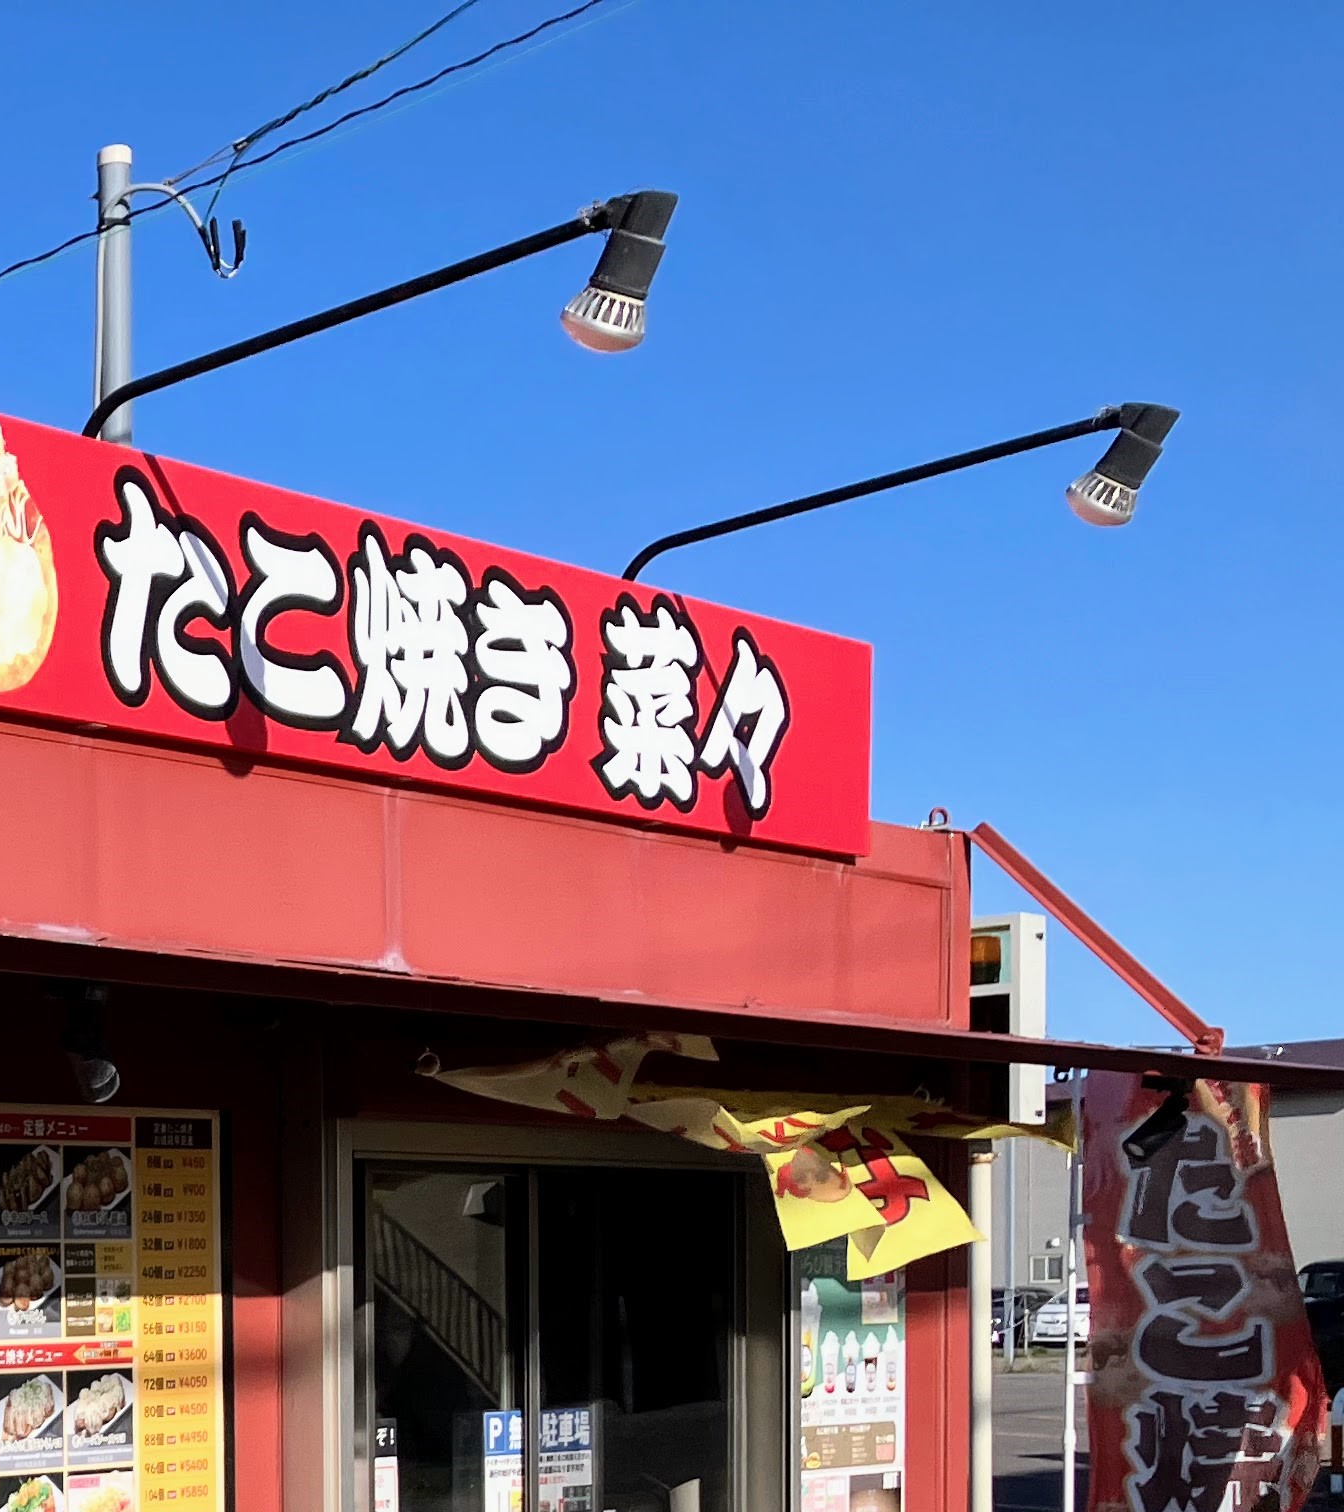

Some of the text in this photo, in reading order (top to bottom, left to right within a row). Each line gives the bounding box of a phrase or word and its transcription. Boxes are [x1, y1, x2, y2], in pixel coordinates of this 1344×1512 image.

[98, 466, 790, 820] たこ焼き 菜々
[23, 1118, 89, 1137] 定番メニュー
[143, 1376, 208, 1390] 72個 ¥4050
[489, 1411, 591, 1450] P 無駐車場
